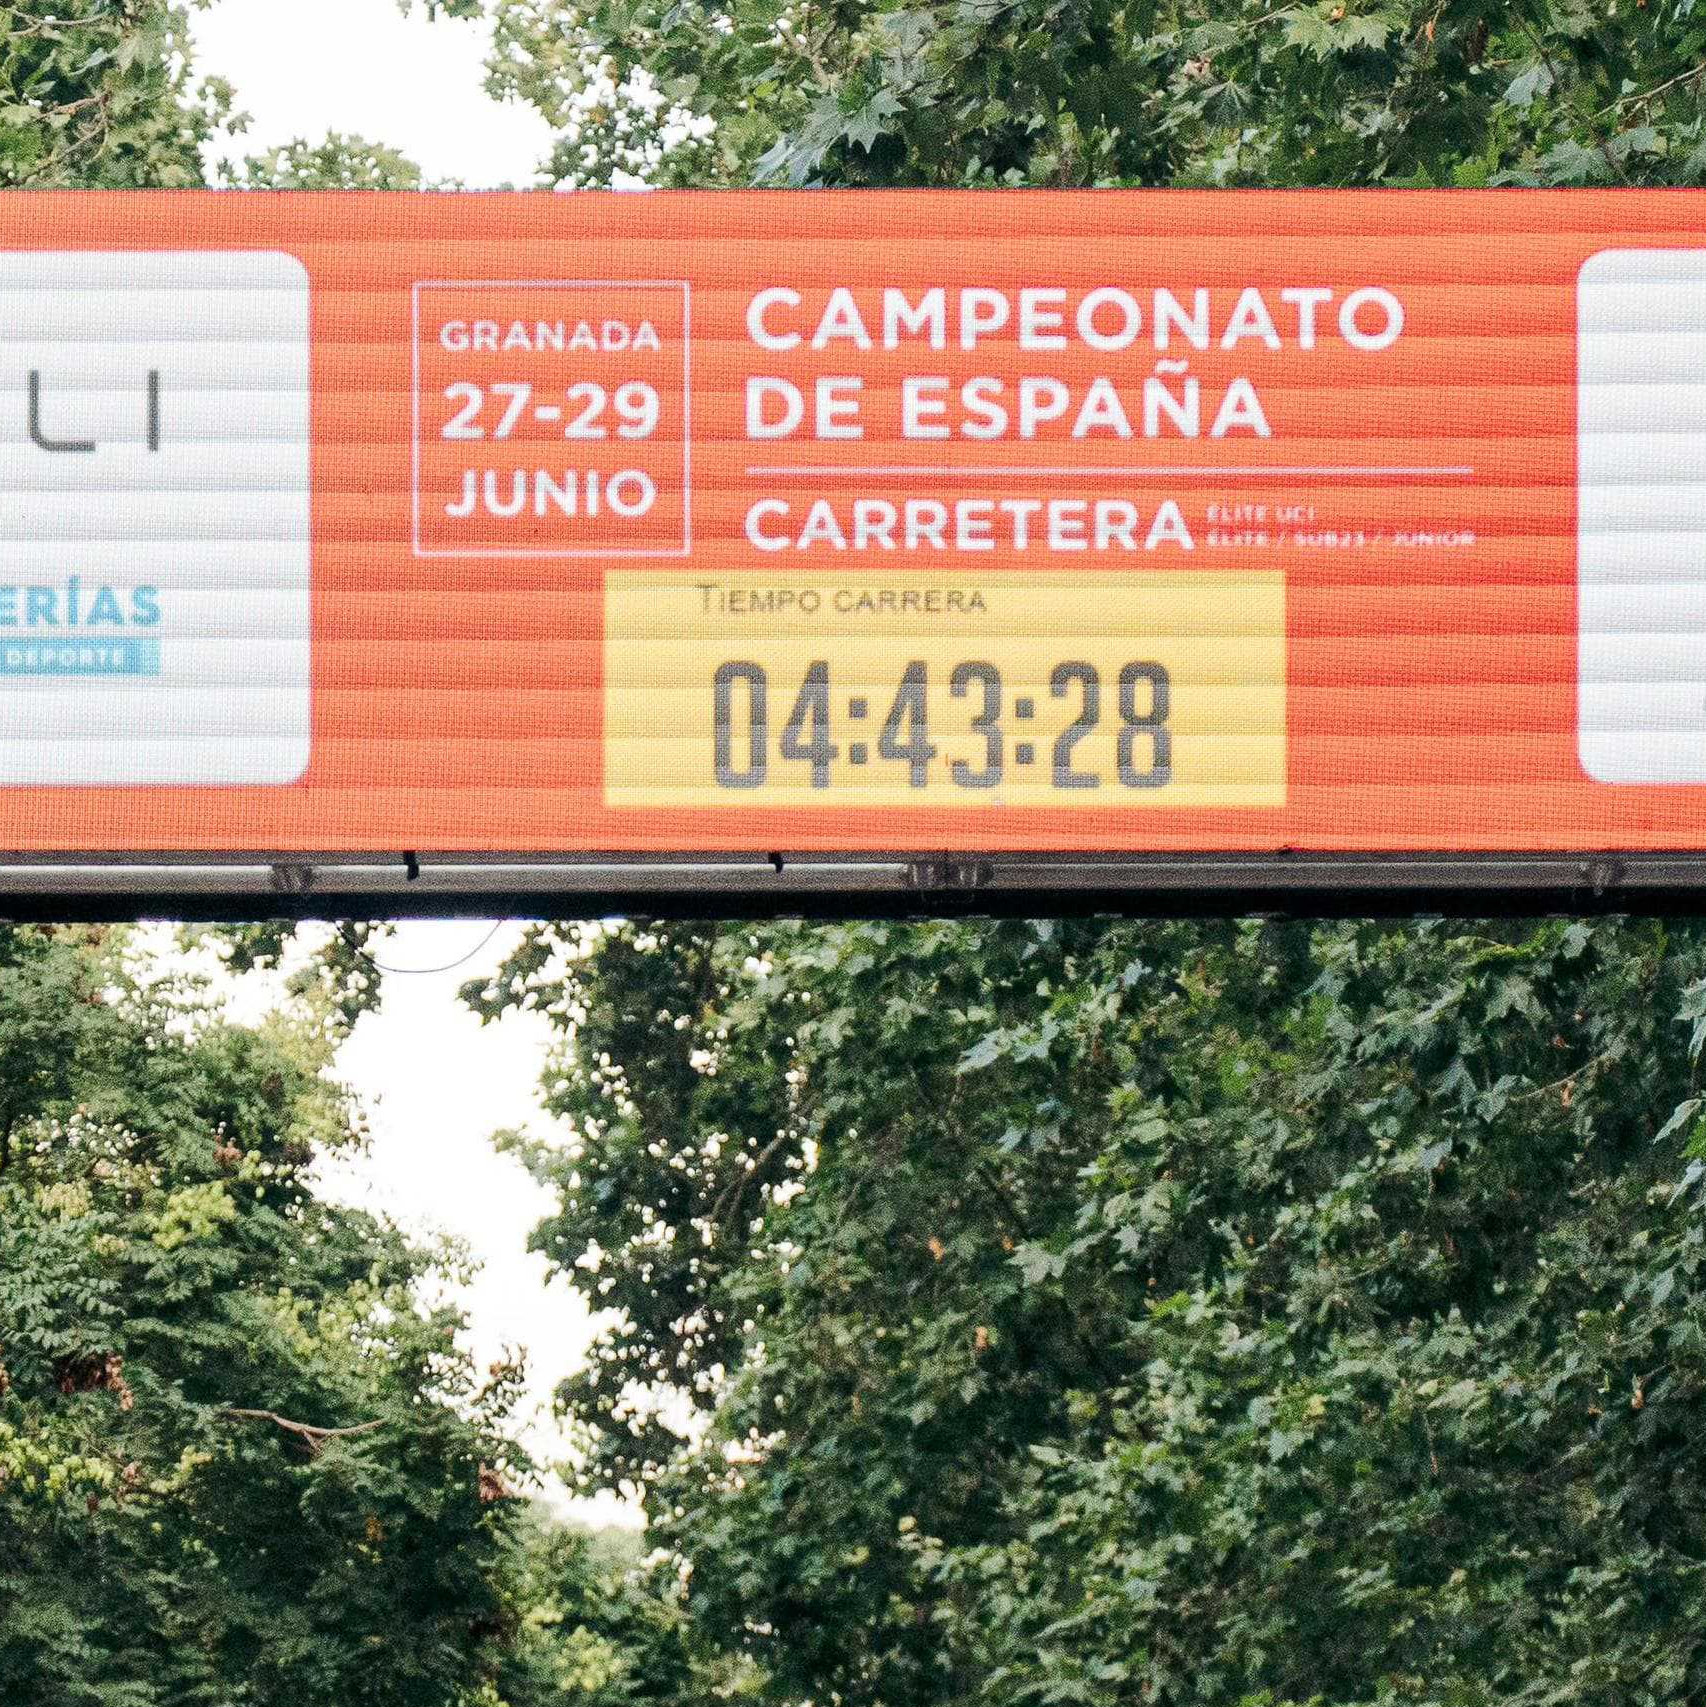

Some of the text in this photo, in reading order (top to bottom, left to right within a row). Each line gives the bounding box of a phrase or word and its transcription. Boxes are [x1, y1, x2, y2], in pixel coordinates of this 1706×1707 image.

[440, 319, 662, 354] GRANADA
[745, 286, 1406, 353] CAMPEONATO
[440, 381, 662, 441] 27-29
[745, 359, 1272, 441] DE ESPAÑA
[443, 470, 656, 517] JUNIO
[743, 499, 1195, 552] CARRETERA
[6, 646, 126, 668] DEPORTE
[712, 659, 1173, 791] 04:43:28
